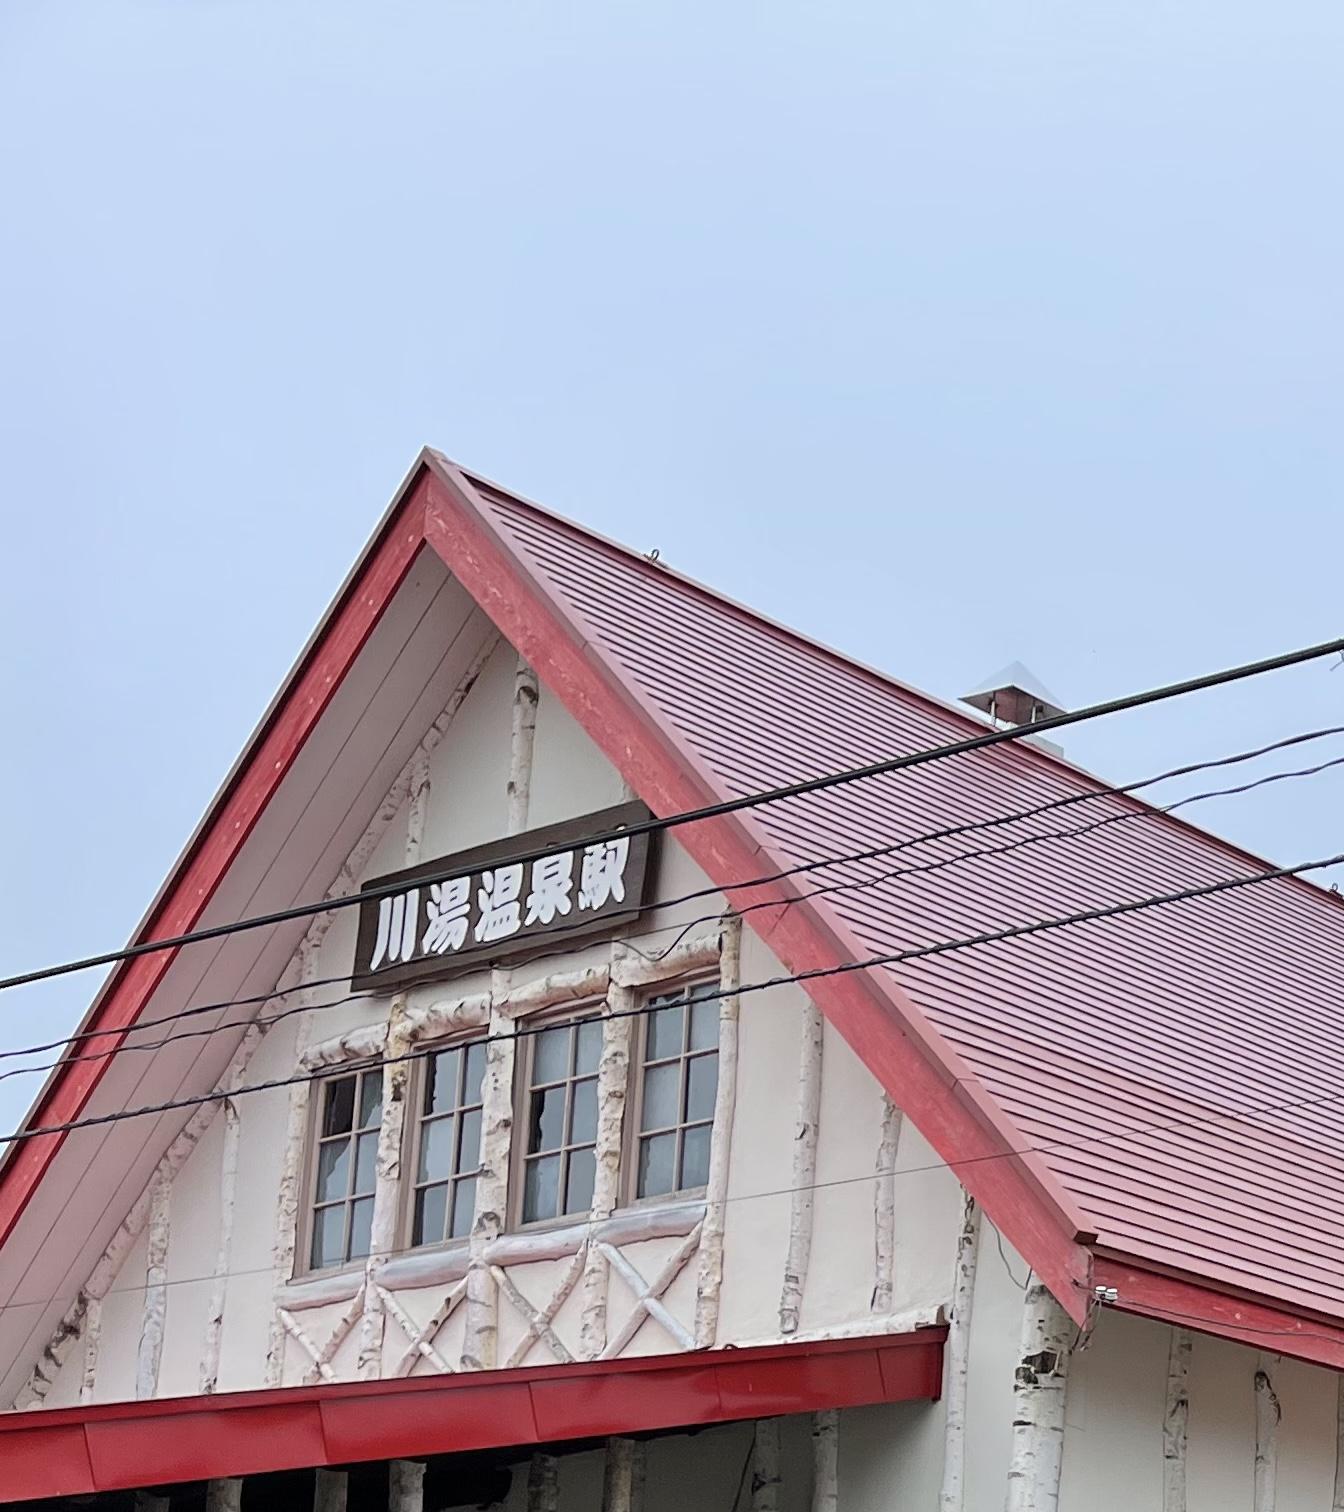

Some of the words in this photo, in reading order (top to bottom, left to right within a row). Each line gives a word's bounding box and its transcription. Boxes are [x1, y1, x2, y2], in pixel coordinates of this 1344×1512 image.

[369, 832, 630, 972] 川湯温泉駅
